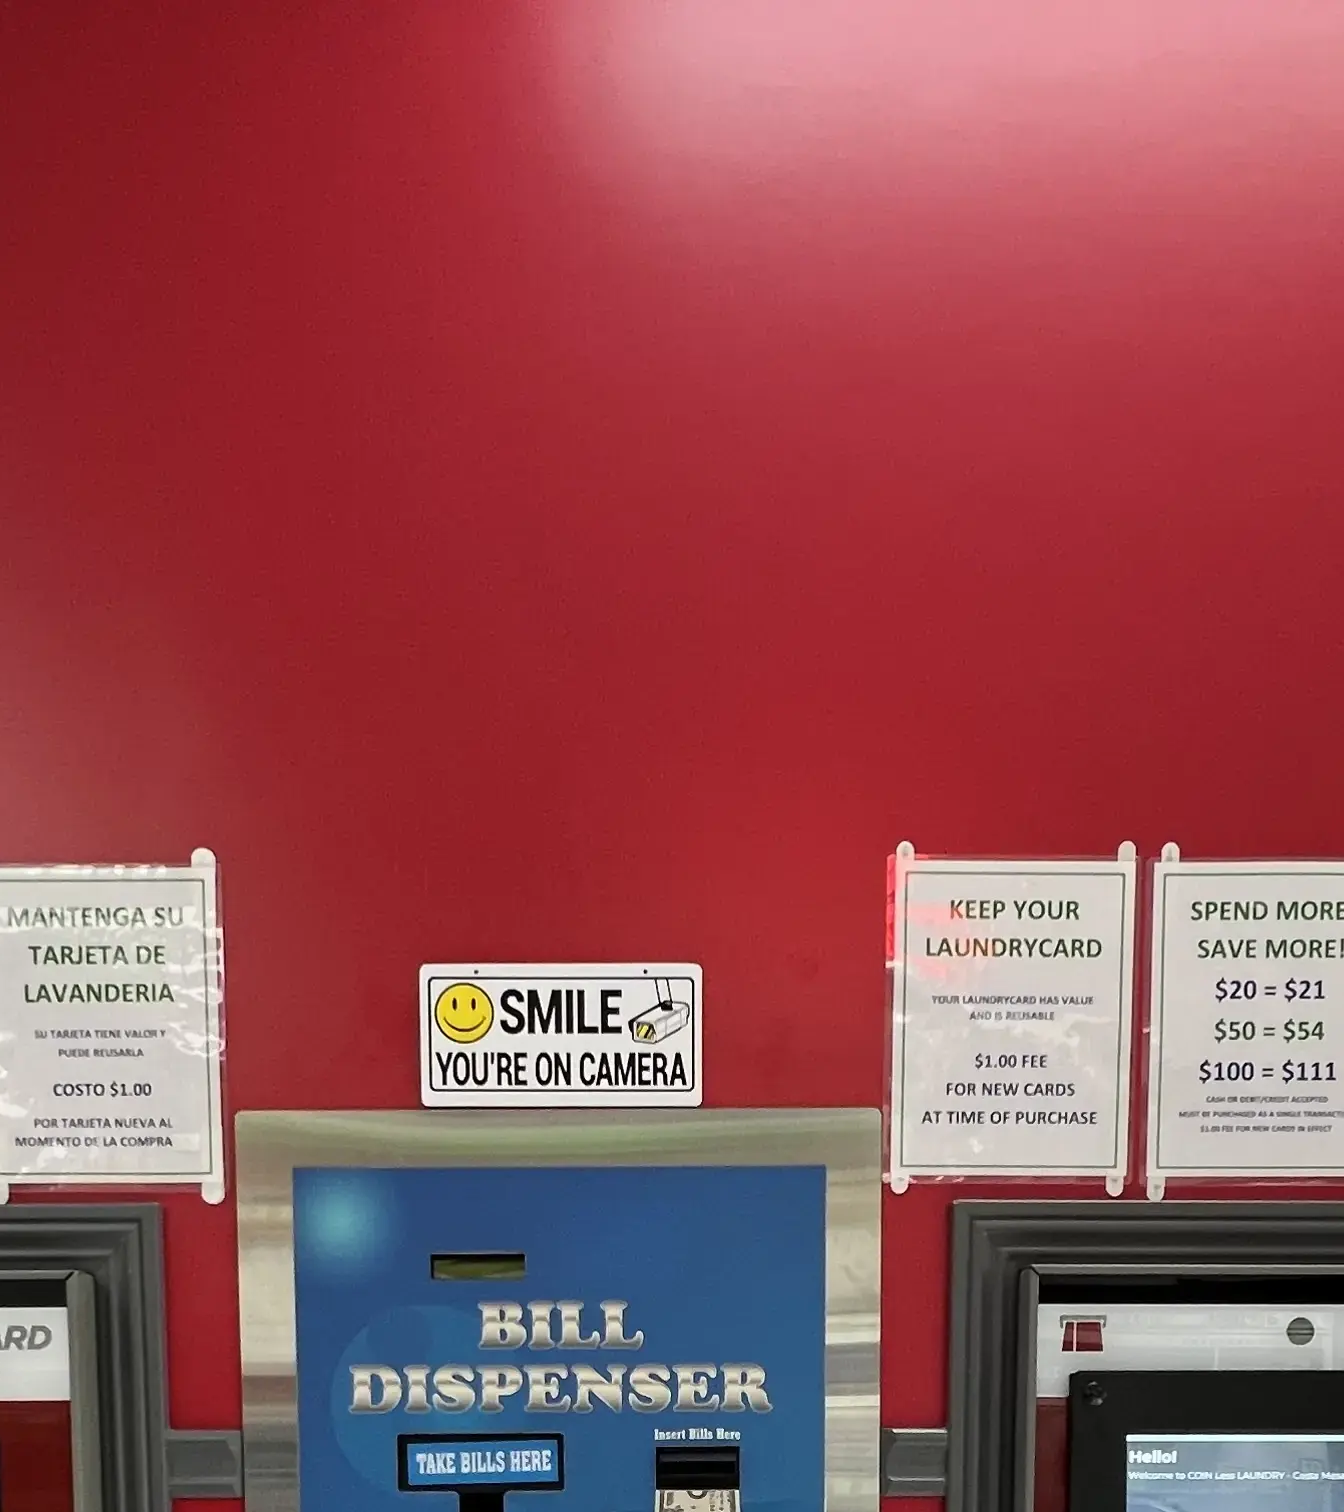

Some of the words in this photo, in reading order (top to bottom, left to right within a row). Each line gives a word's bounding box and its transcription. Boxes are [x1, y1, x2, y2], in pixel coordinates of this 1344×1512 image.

[8, 906, 147, 928] MANTENGA
[154, 904, 183, 928] SU
[950, 900, 1005, 919] KEEP
[1014, 900, 1079, 920] YOUR
[1191, 901, 1268, 921] SPEND
[28, 945, 129, 965] TARJETA
[136, 945, 165, 964] DE
[926, 938, 1102, 958] LAUNDRYCARD
[1198, 940, 1256, 958] SAVE
[1266, 938, 1344, 958] MORE!
[24, 984, 174, 1003] LAVANDERIA
[1216, 977, 1256, 1003] $20
[1264, 986, 1276, 996] =
[1284, 978, 1325, 1002] $21
[500, 989, 622, 1034] SMILE
[1214, 1018, 1256, 1044] $50
[1263, 1027, 1276, 1036] =
[1283, 1018, 1324, 1043] $54
[435, 1051, 527, 1086] YOU'RE
[536, 1052, 571, 1086] ON
[580, 1052, 686, 1086] CAMERA
[975, 1053, 1017, 1069] $1.00
[1022, 1055, 1047, 1068] FEE
[1199, 1060, 1254, 1084] $100
[1262, 1068, 1274, 1077] =
[1282, 1059, 1336, 1084] $111
[946, 1083, 976, 1096] FOR
[982, 1083, 1019, 1096] NEW
[1024, 1083, 1075, 1096] CARDS
[922, 1111, 942, 1124] AT
[946, 1111, 985, 1124] TIME
[990, 1111, 1010, 1124] OF
[1016, 1111, 1097, 1124] PURCHASE
[477, 1300, 644, 1350] BILL
[348, 1364, 772, 1414] DISPENSER
[654, 1429, 686, 1440] Insert
[688, 1428, 713, 1440] Bills
[716, 1428, 740, 1440] Here
[416, 1453, 456, 1474] TAKE
[460, 1451, 505, 1473] BILLS
[510, 1449, 552, 1472] HERE
[1128, 1450, 1177, 1464] Hello!
